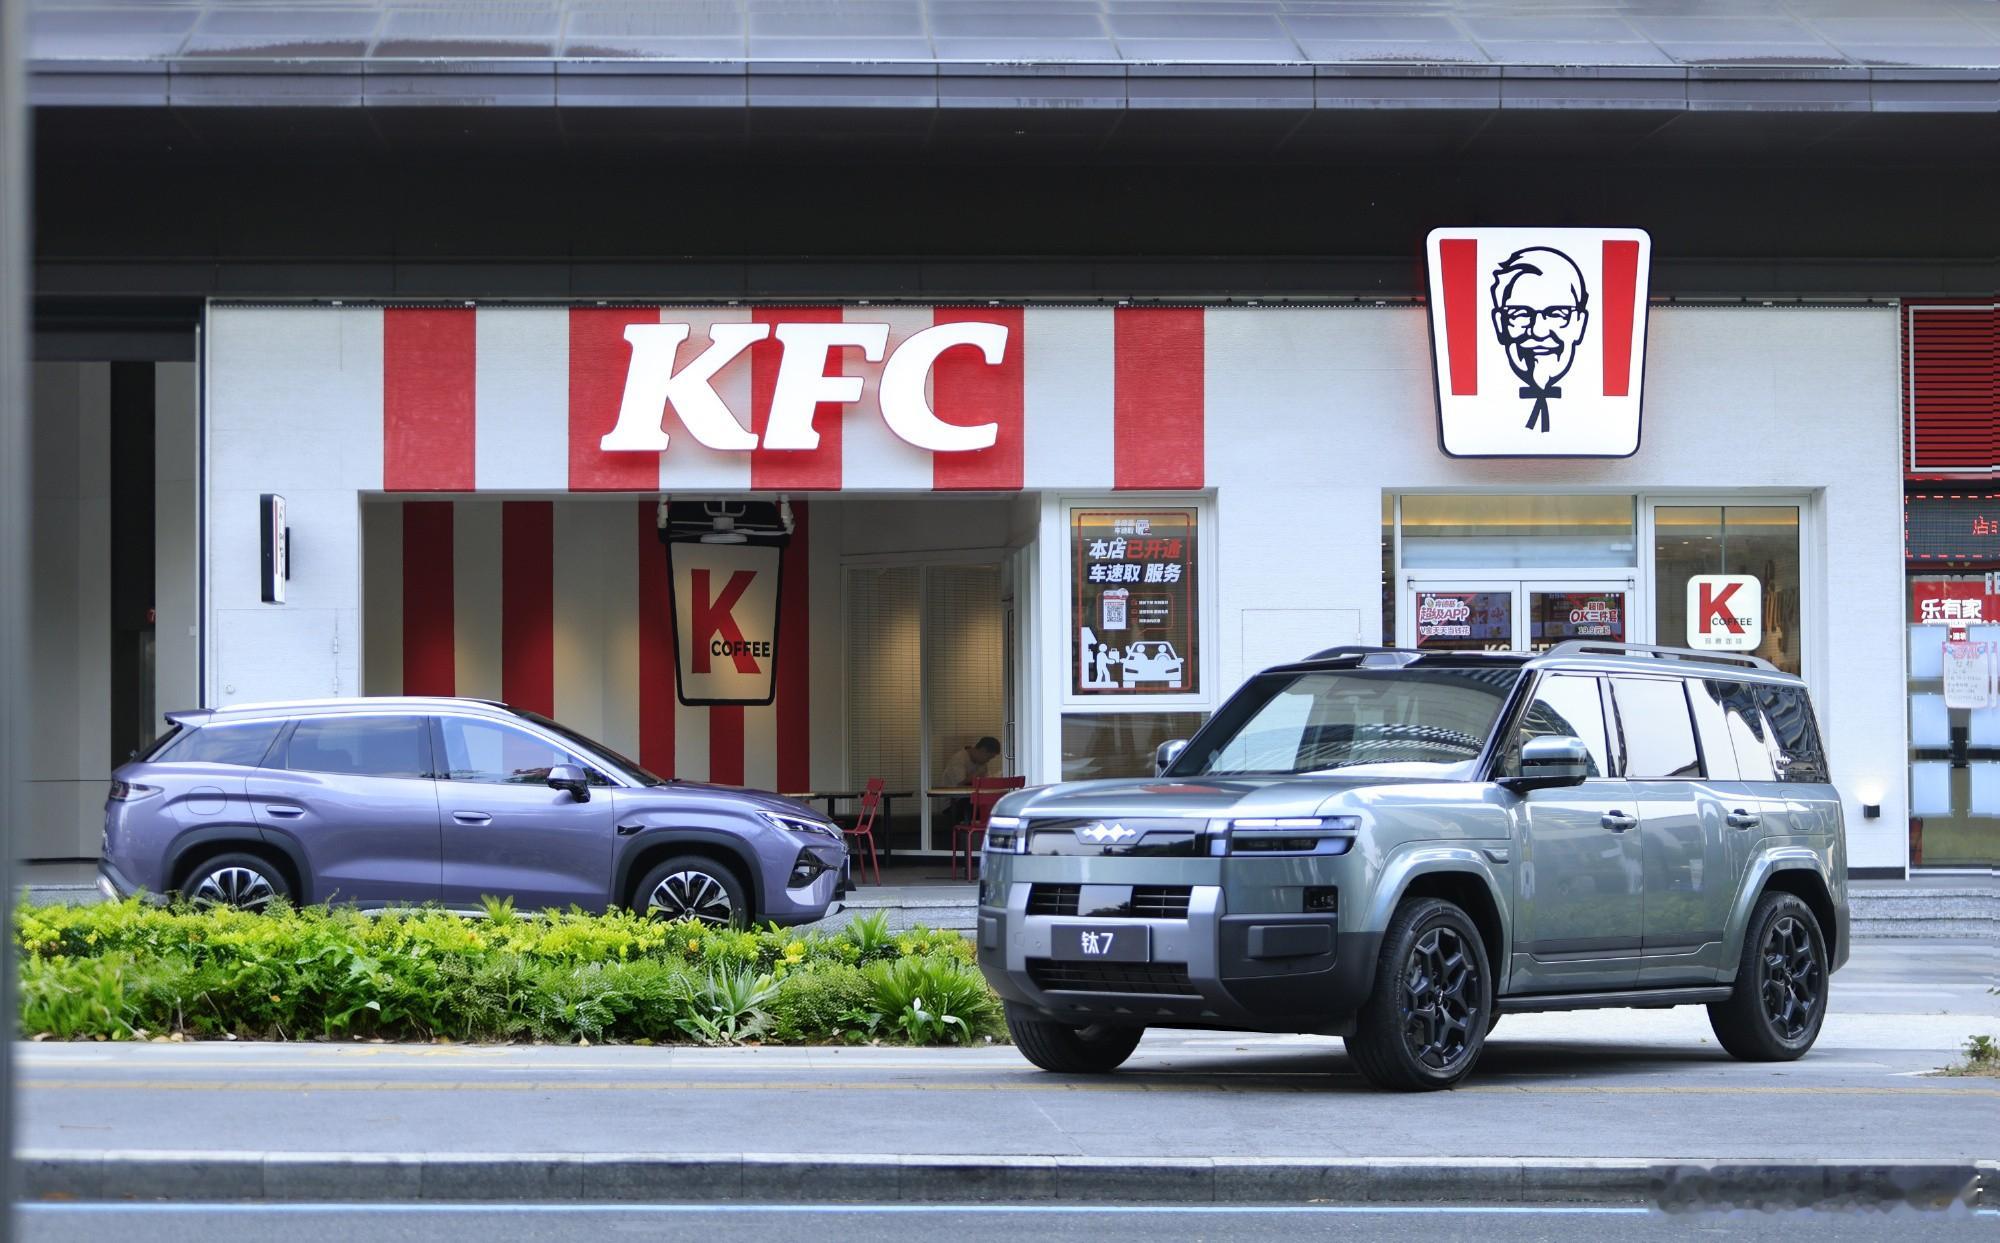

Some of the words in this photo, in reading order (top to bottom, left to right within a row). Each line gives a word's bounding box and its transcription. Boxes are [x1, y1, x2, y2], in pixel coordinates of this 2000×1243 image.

[600, 321, 1009, 453] KFC
[1088, 538, 1183, 560] 本店已开通
[1088, 563, 1142, 583] 车速取
[1144, 563, 1182, 583] 服务
[1420, 606, 1469, 621] 超级APP
[1699, 582, 1746, 634] K
[1921, 598, 1982, 619] 乐有家
[691, 569, 762, 674] K
[1711, 617, 1753, 626] COFFEE
[711, 640, 771, 658] COFFEE
[1081, 931, 1114, 955] 钛7
